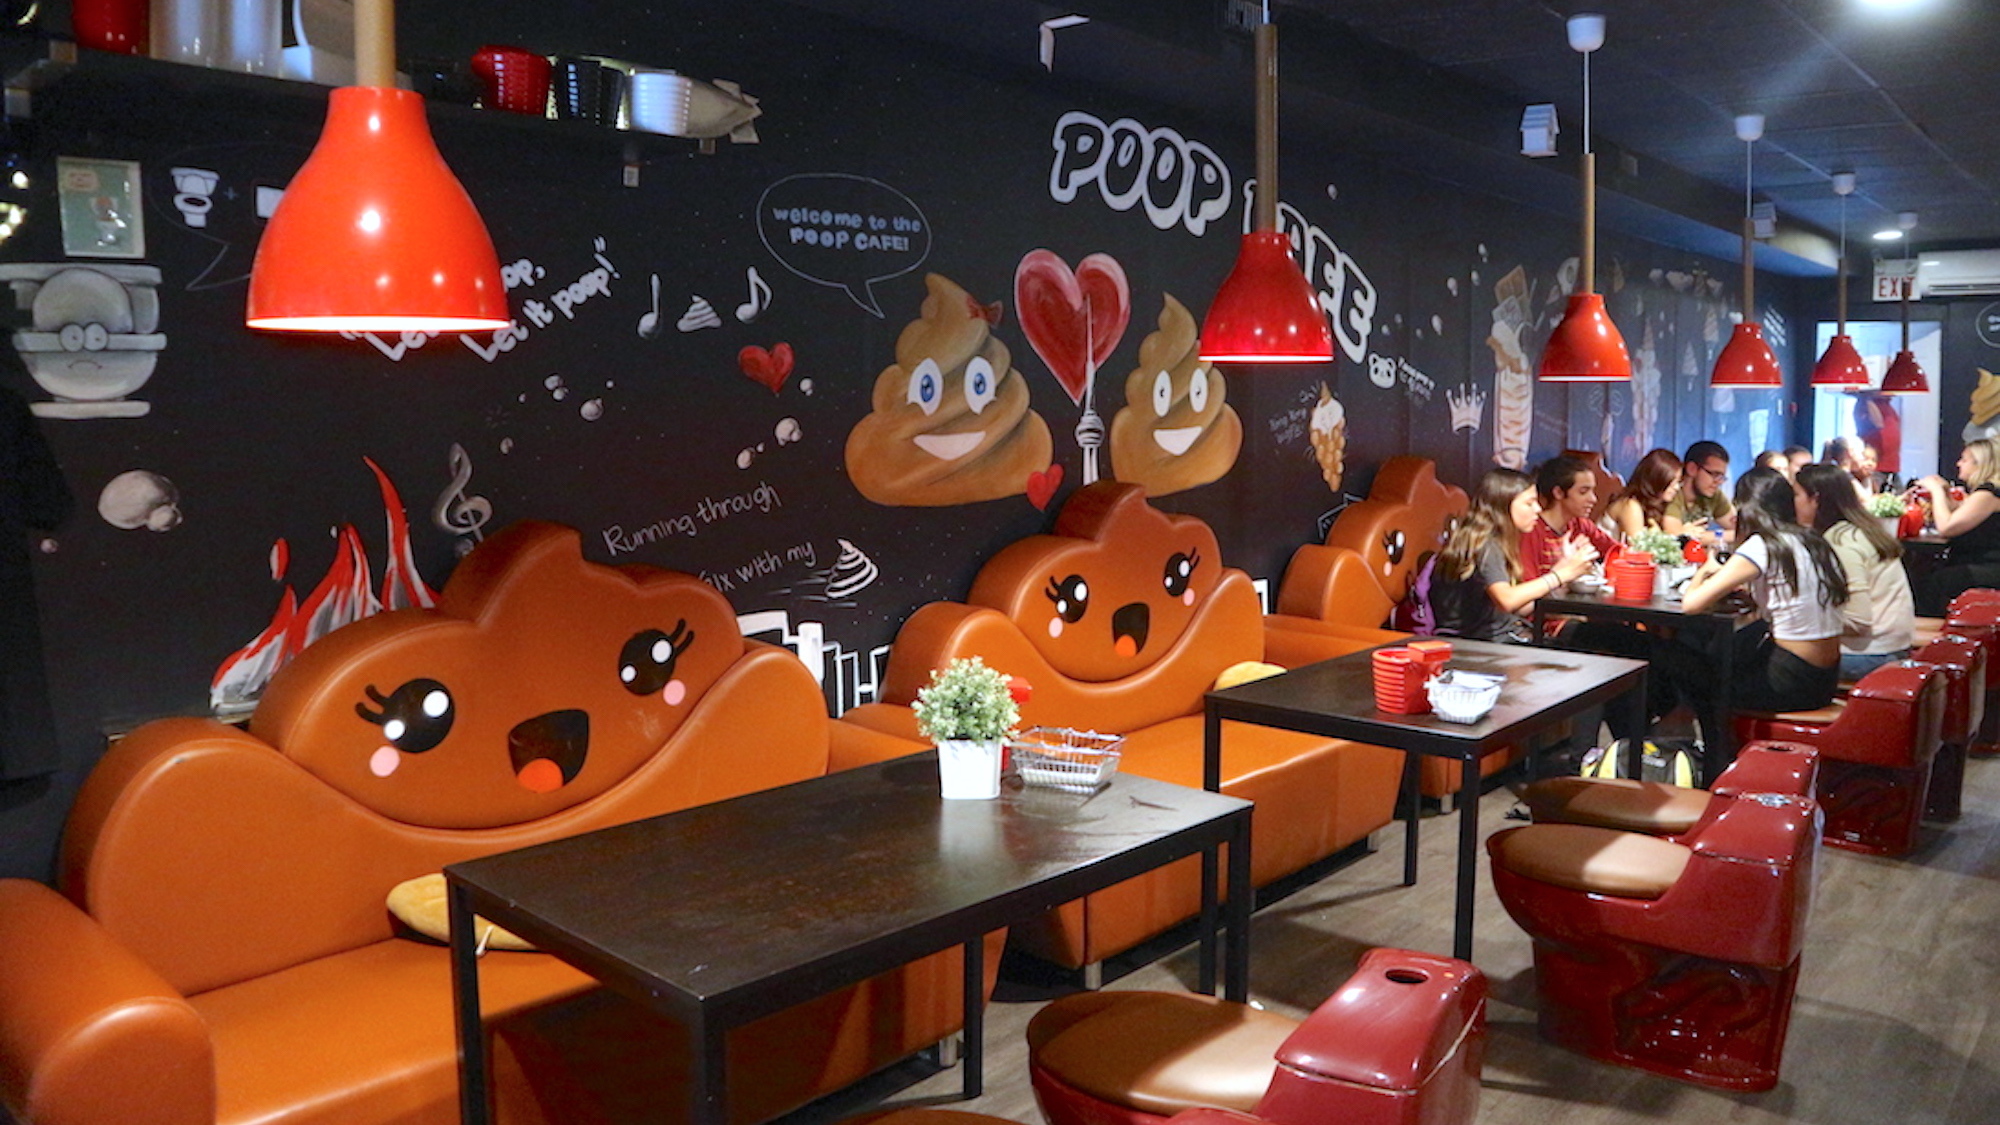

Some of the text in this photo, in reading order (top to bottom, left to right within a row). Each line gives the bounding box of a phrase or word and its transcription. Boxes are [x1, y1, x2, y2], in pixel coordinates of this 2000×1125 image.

[773, 207, 921, 233] welcome to the
[789, 226, 909, 251] POOP CAFE!
[1049, 110, 1378, 364] POOP FE
[459, 319, 530, 363] Let
[602, 480, 782, 557] Running through
[736, 549, 783, 583] with
[786, 541, 817, 568] my
